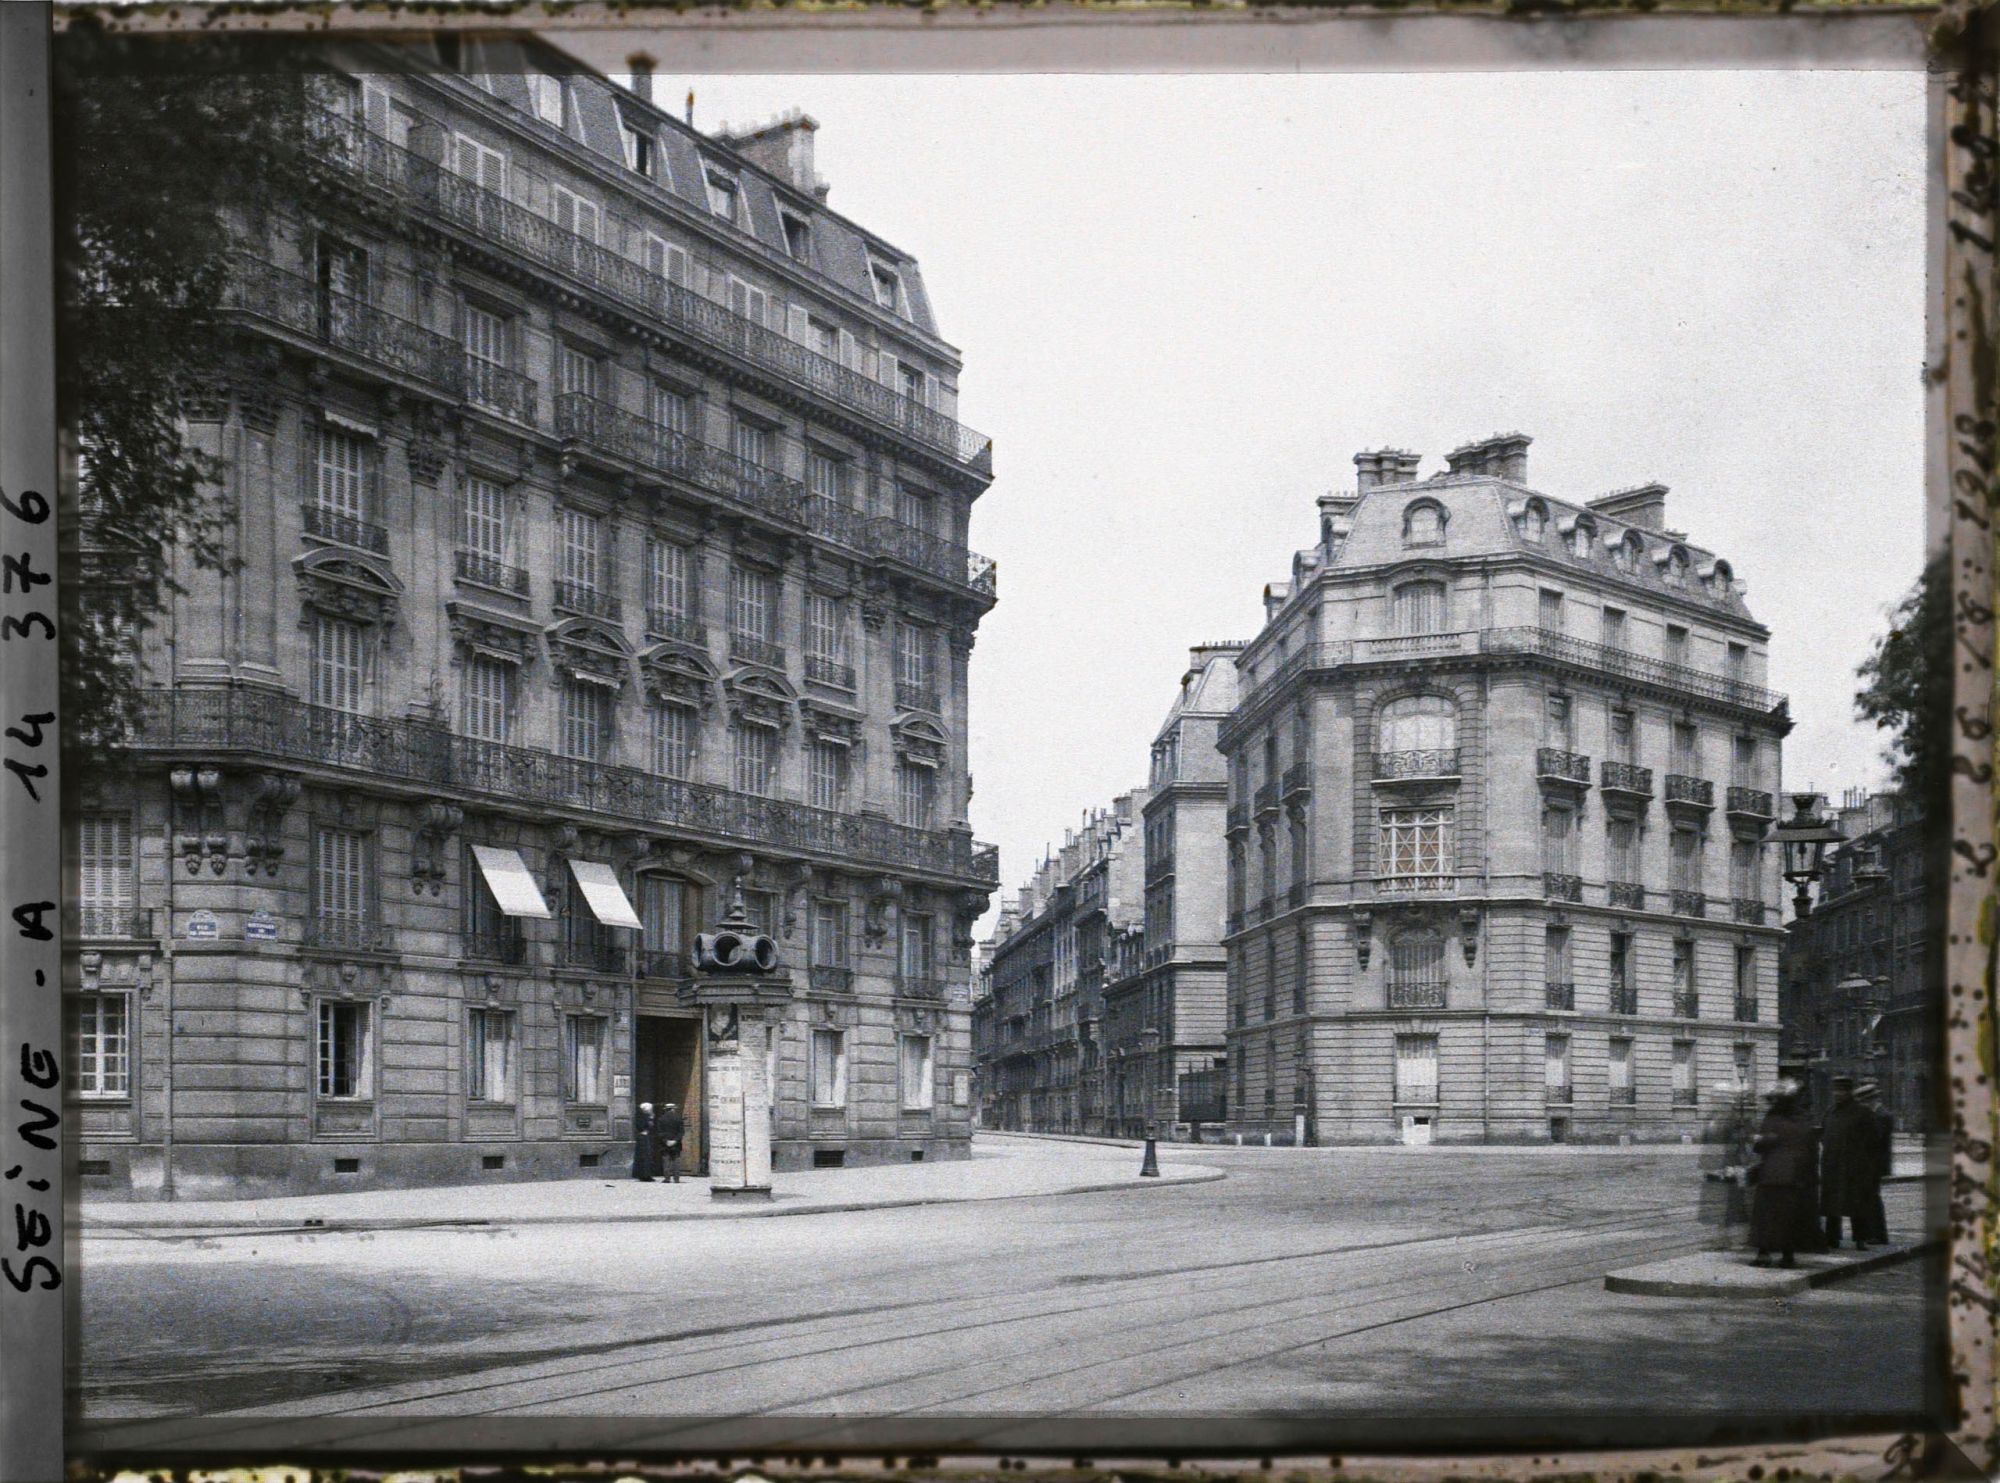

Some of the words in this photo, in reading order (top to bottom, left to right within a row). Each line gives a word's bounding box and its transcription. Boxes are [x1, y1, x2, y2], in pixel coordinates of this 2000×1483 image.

[0, 487, 56, 641] 376
[3, 711, 57, 804] 14
[11, 901, 56, 942] A
